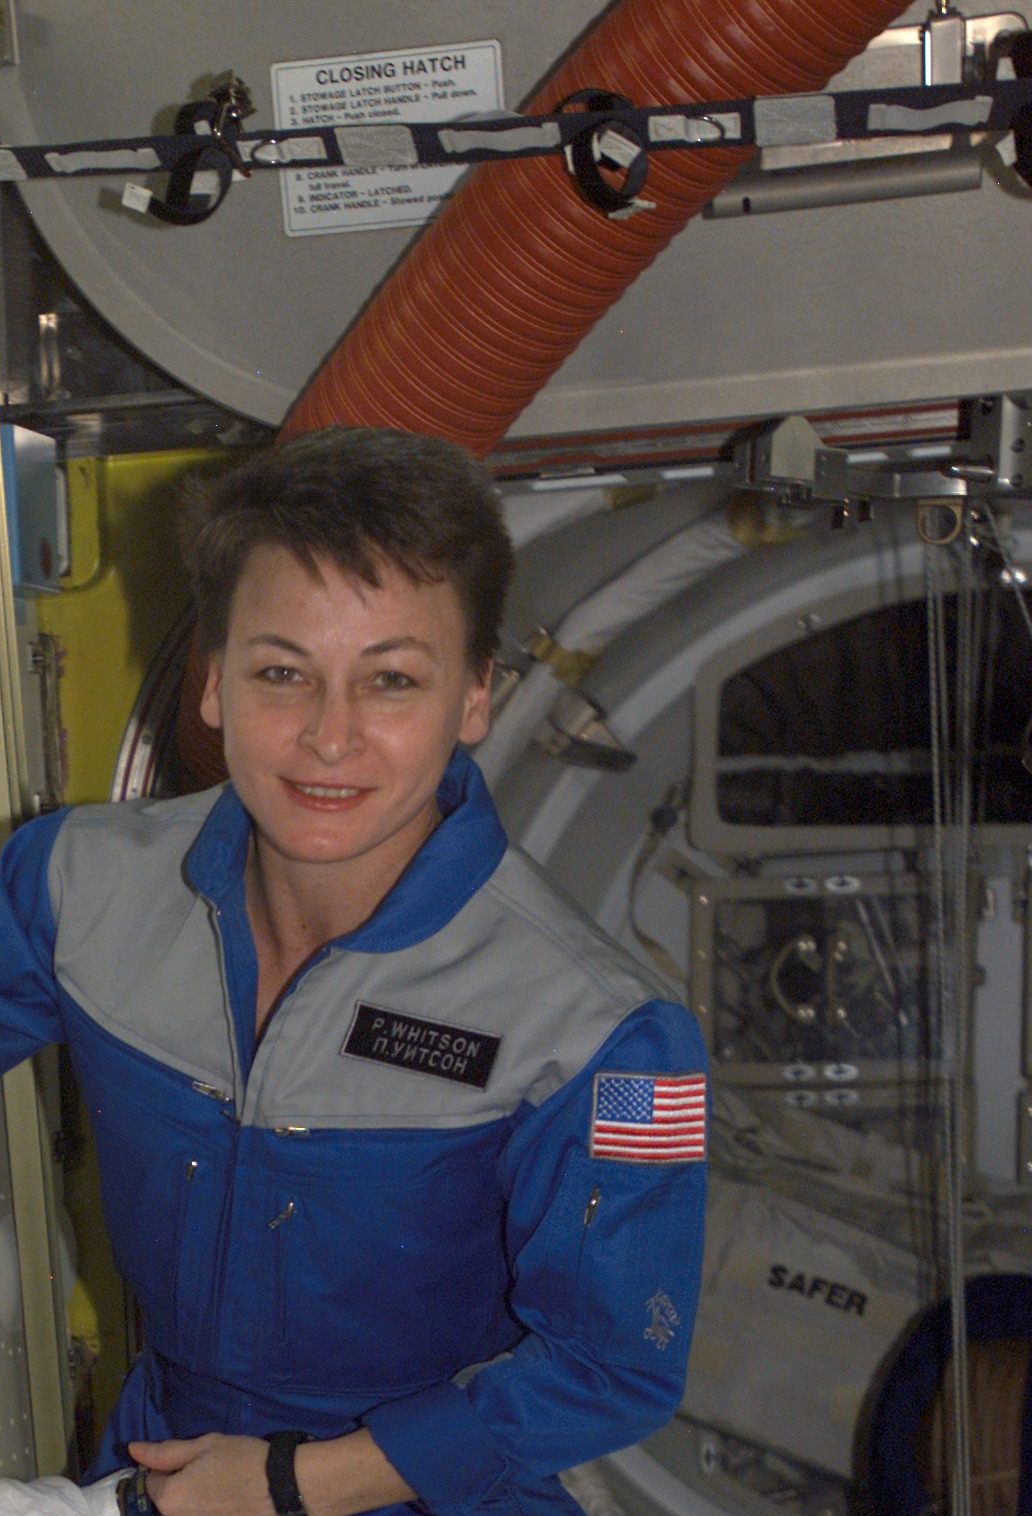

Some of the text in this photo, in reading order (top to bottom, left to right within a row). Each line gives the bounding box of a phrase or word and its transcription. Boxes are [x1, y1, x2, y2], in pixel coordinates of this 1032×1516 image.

[316, 54, 466, 85] CLOSING HATCH
[300, 90, 346, 102] STOWAGE
[349, 86, 380, 98] LATCH
[383, 82, 421, 94] BUTTON
[301, 101, 346, 114] STOWAGE
[350, 97, 381, 109] LATCH
[383, 93, 421, 105] HANDLE
[302, 113, 333, 124] HATCH
[344, 111, 365, 120] Push
[307, 169, 338, 180] CRANK
[341, 165, 376, 176] HANDLE
[309, 190, 357, 201] INDICATOR
[310, 203, 341, 213] CRANK
[344, 198, 380, 210] HANDLE
[390, 195, 425, 206] Stowed
[769, 1264, 867, 1316] SAFER
